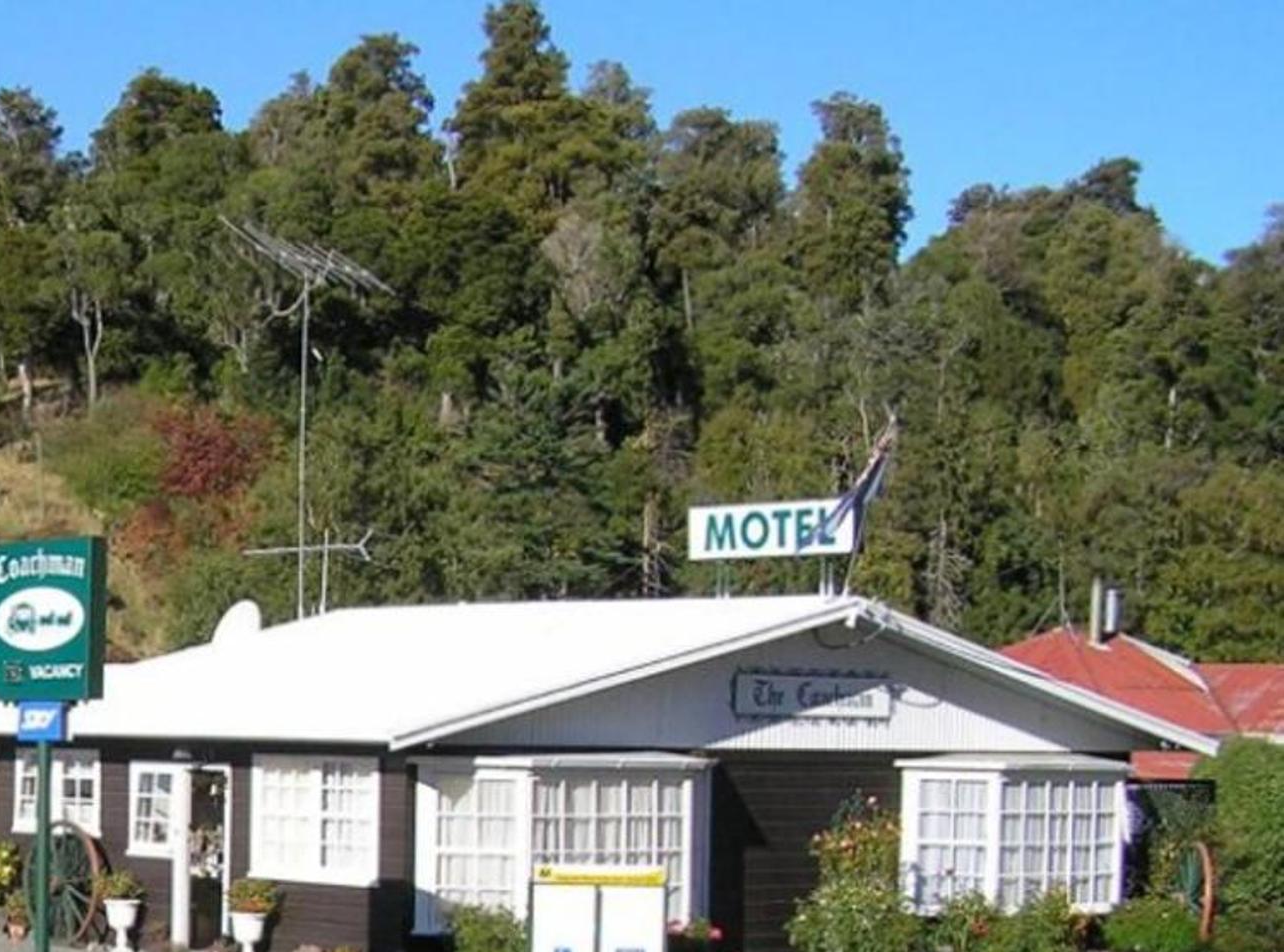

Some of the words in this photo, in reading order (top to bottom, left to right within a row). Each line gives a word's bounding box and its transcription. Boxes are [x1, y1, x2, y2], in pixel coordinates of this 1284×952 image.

[704, 507, 836, 551] MOTEL
[29, 663, 84, 680] VACANCY
[752, 679, 785, 709] The
